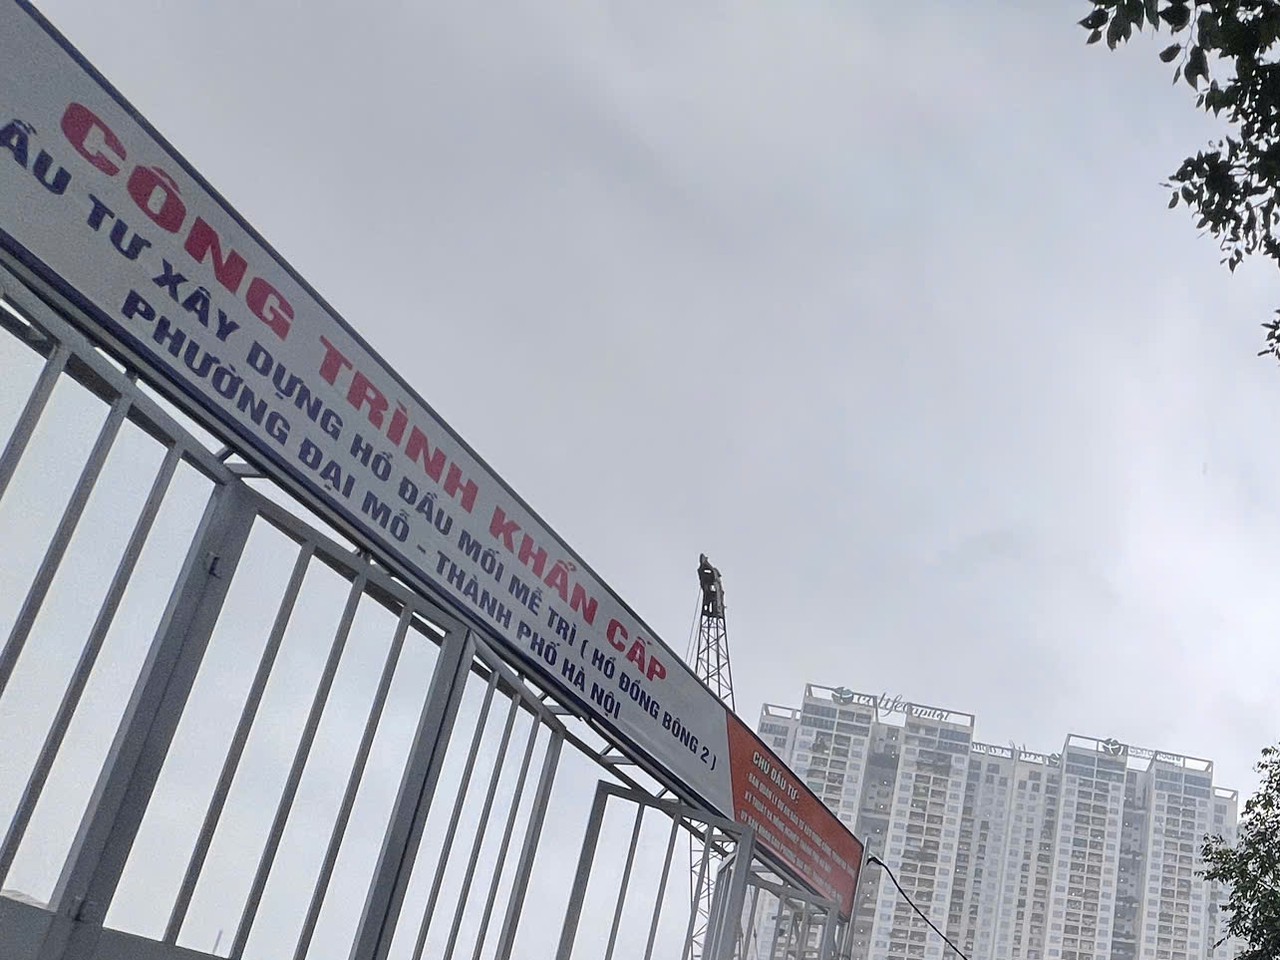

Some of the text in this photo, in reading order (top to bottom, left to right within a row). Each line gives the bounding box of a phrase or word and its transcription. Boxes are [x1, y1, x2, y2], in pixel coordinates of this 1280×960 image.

[61, 102, 668, 682] CÔNG TRÌNH KHẨN CẤP
[87, 193, 152, 261] TƯ
[152, 257, 241, 342] XÂY
[246, 340, 344, 441] DỰNG
[398, 475, 454, 536] ĐẦU
[457, 529, 505, 583] MỐI
[548, 605, 577, 647] TRÌ
[662, 711, 699, 754] BÔNG
[121, 289, 291, 446] PHƯỜNG
[298, 437, 356, 499] ĐẠI
[436, 550, 513, 630] THÀNH
[516, 620, 560, 667] PHỐ
[561, 657, 586, 693] HÀ
[590, 681, 621, 720] NỘI
